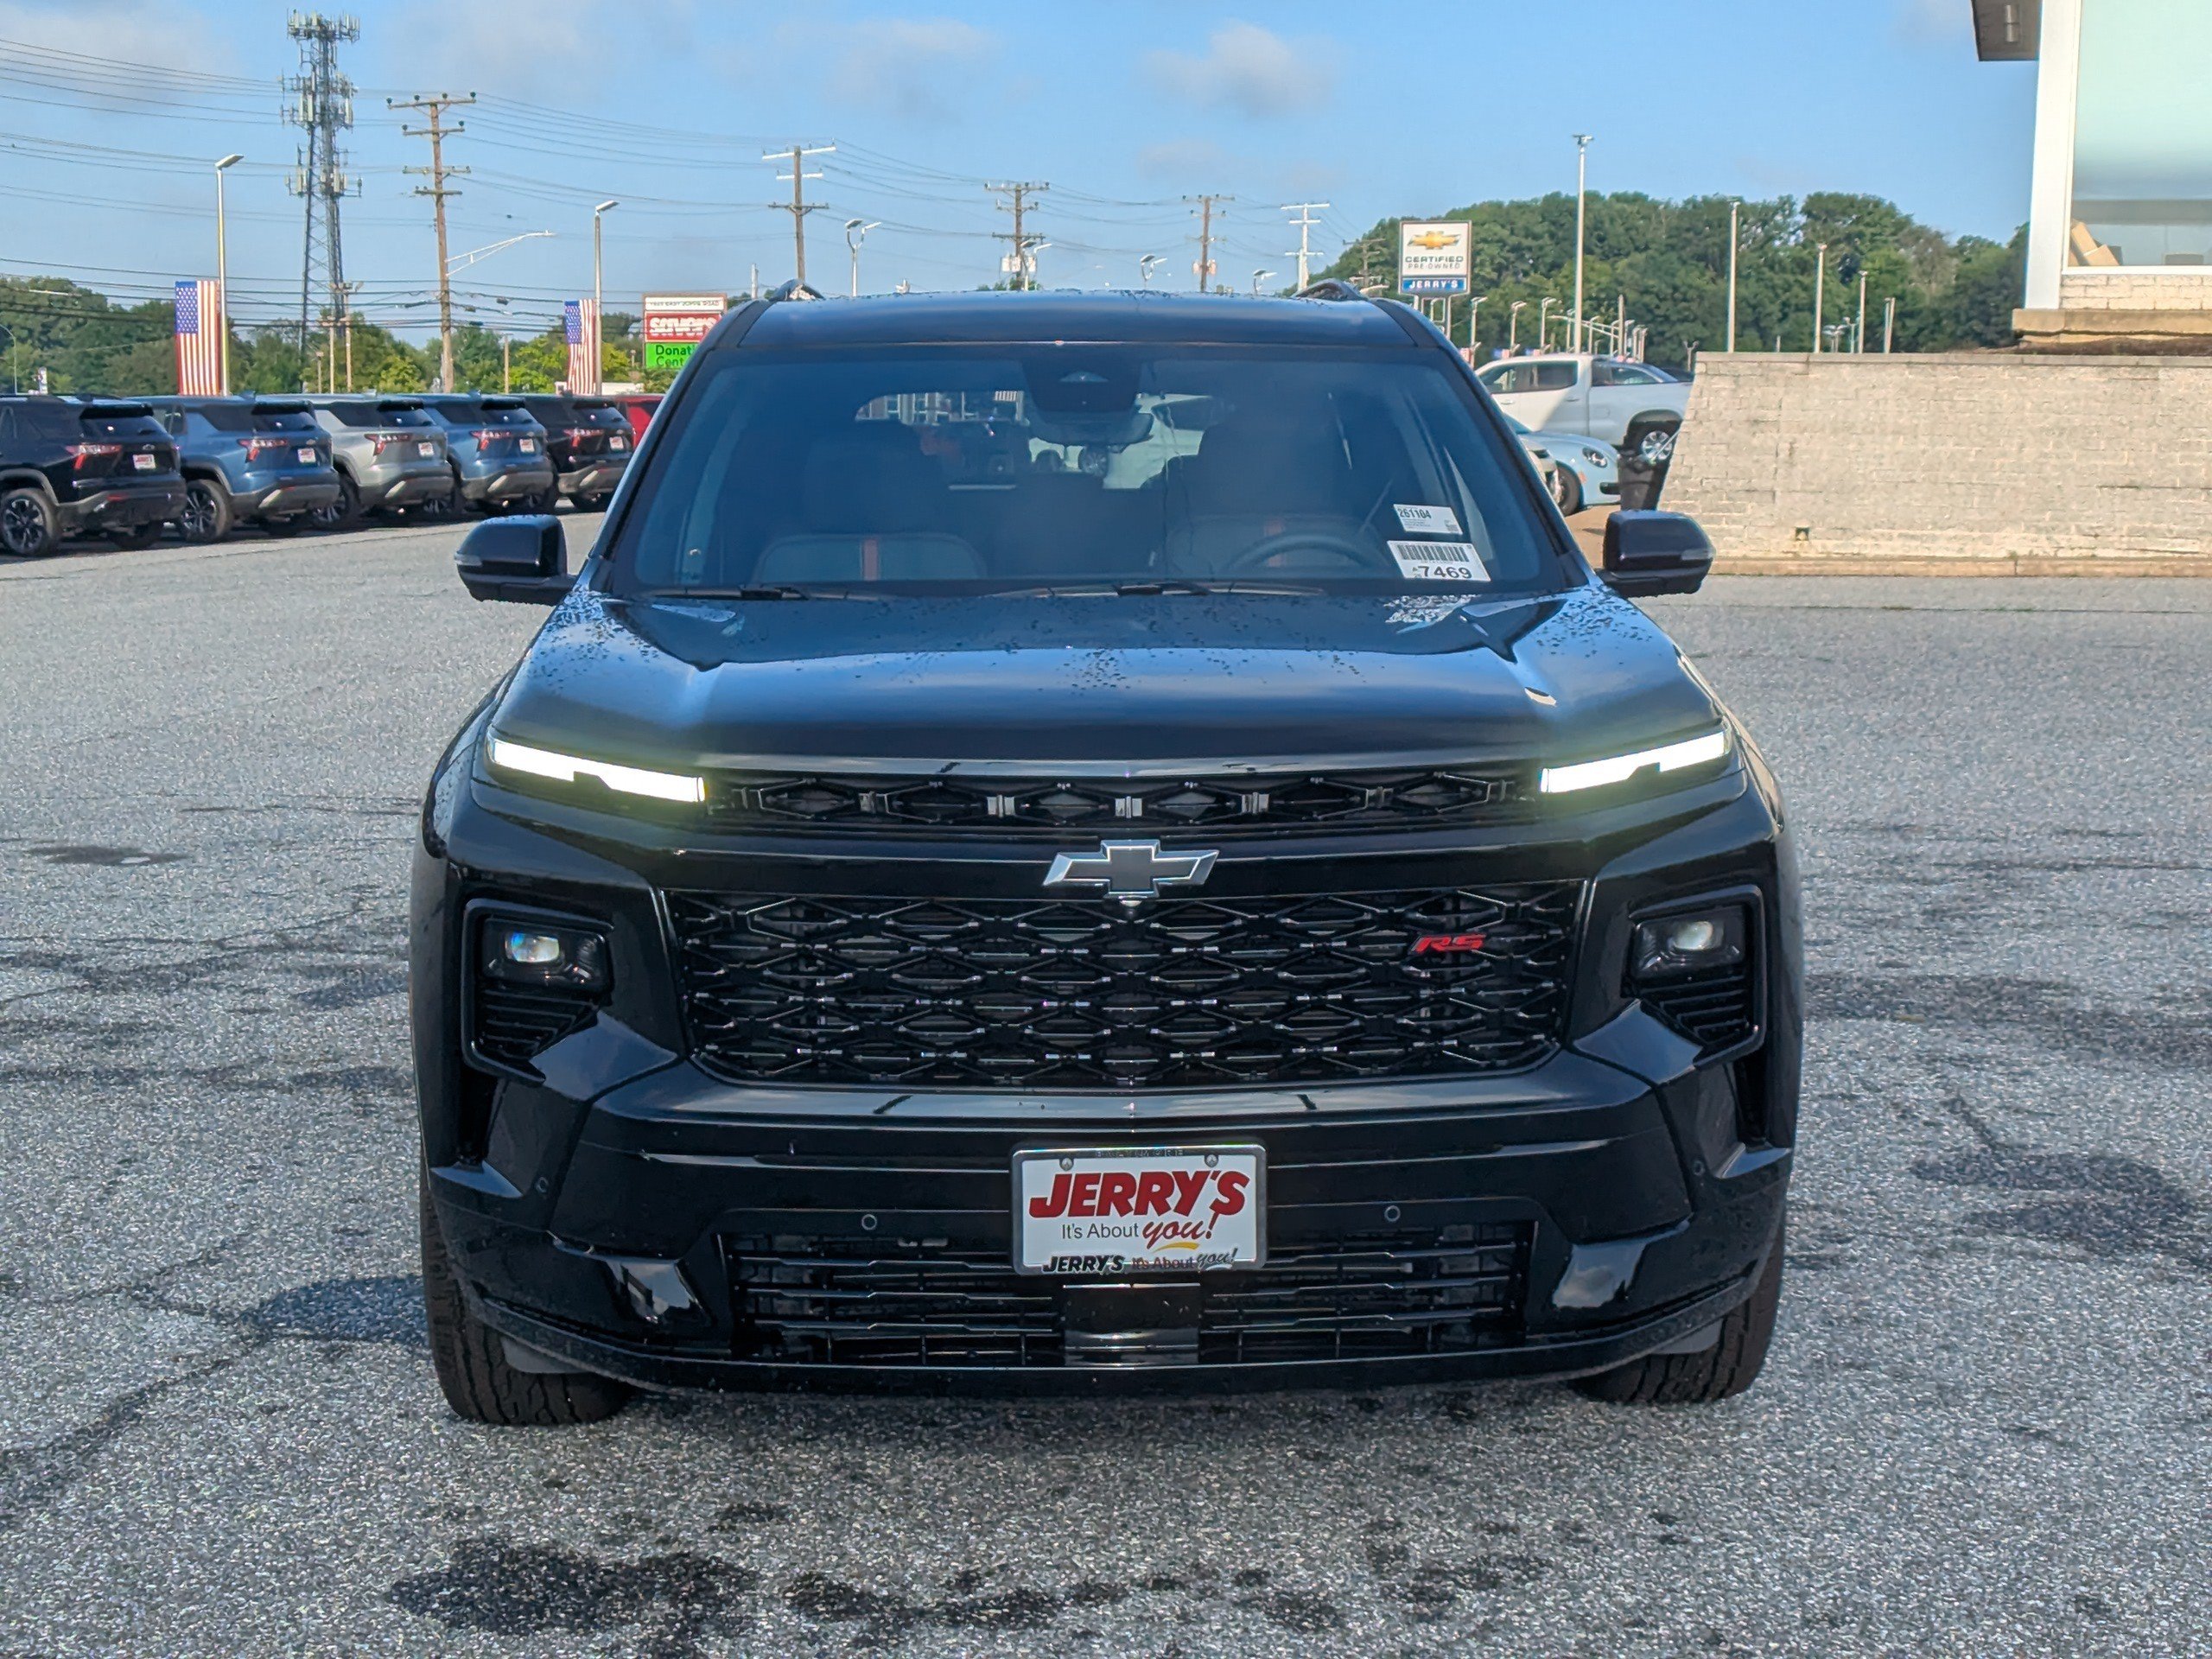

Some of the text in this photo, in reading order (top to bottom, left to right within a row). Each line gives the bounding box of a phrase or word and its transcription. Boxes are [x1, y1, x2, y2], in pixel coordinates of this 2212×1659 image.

[1409, 280, 1458, 289] JERRY'S
[655, 345, 696, 356] Donat
[1396, 508, 1432, 519] 261104
[1418, 566, 1472, 579] 7469
[1410, 934, 1486, 953] RS
[1028, 1170, 1250, 1218] JERRY'S
[1062, 1212, 1219, 1249] It's About you!
[1042, 1255, 1126, 1273] JERRY'S
[1151, 1255, 1195, 1269] About
[1196, 1247, 1239, 1268] you!
